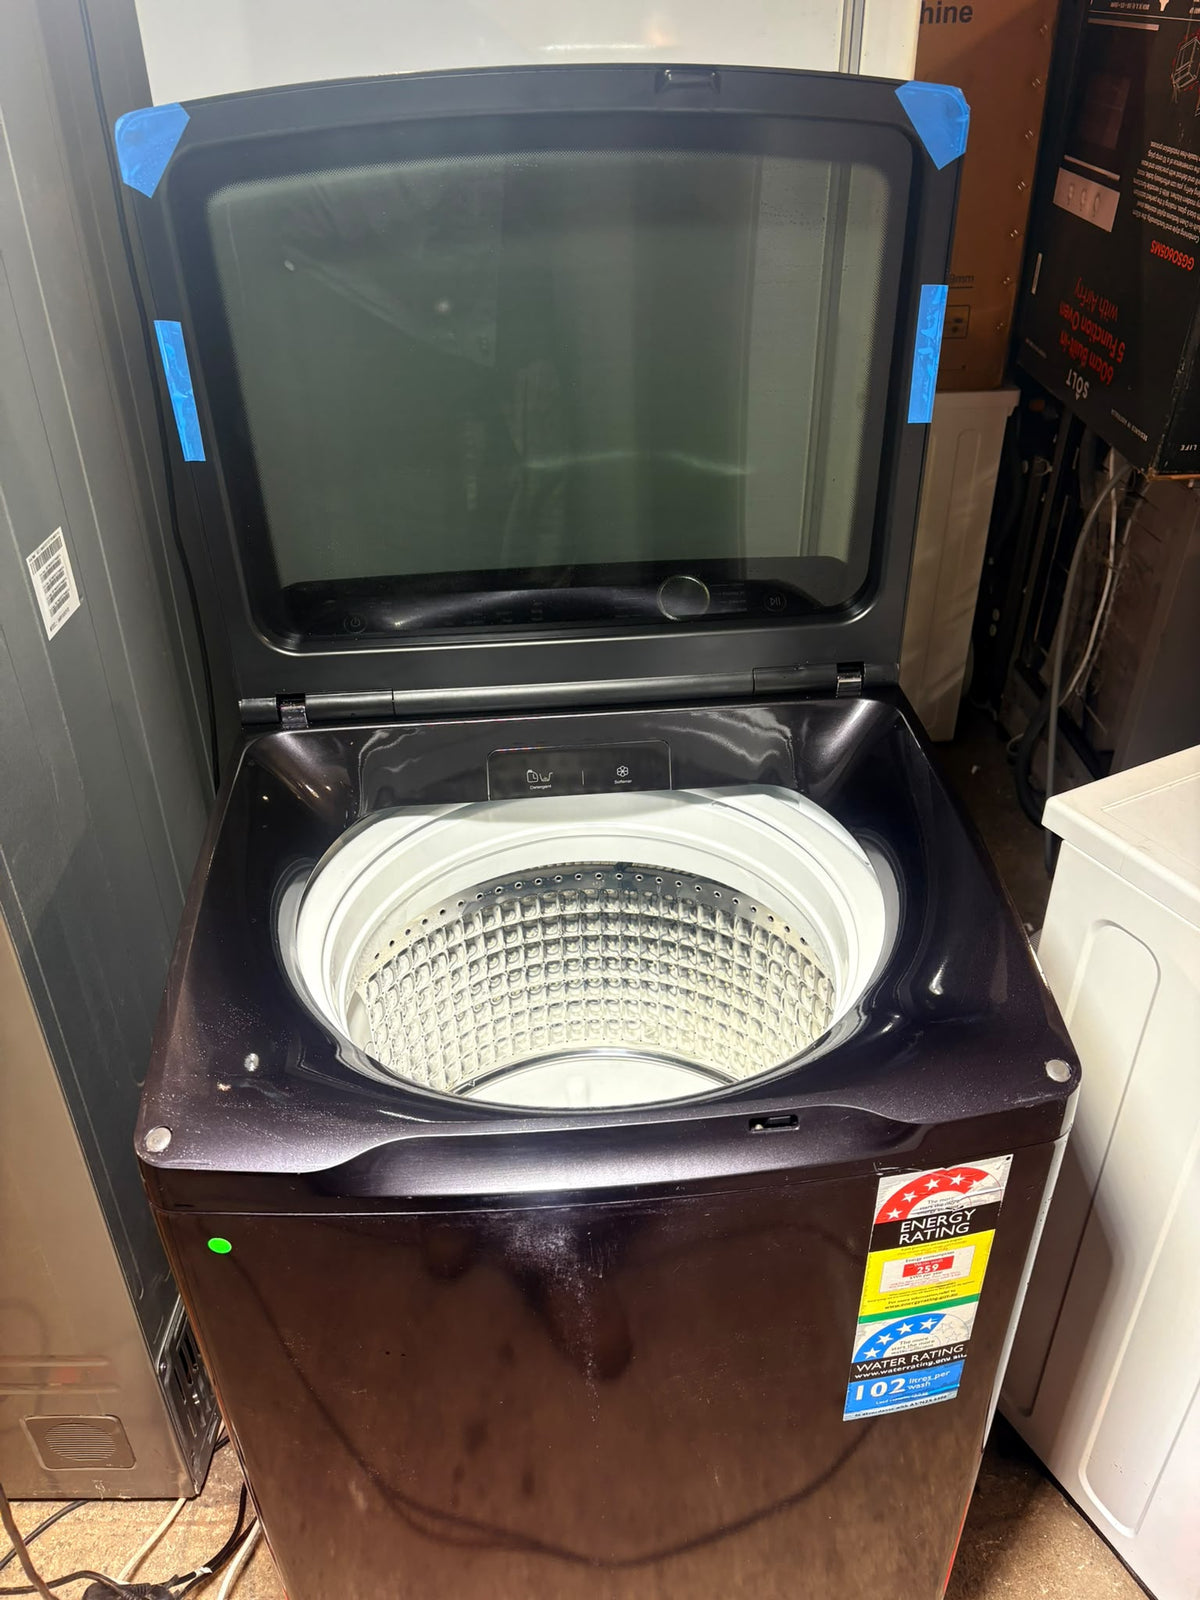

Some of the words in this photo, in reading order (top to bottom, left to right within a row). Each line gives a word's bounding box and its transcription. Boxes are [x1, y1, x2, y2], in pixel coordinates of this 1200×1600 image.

[920, 0, 973, 24] hine
[1060, 300, 1080, 331] Oven
[1099, 298, 1118, 322] with
[1080, 316, 1118, 358] Function
[1116, 342, 1125, 363] 5
[1089, 351, 1114, 385] 60cm
[900, 1208, 976, 1232] ENERGY
[899, 1222, 970, 1244] RATING
[916, 1264, 939, 1274] 259
[856, 1358, 906, 1372] WATER
[911, 1344, 964, 1362] RATING
[856, 1378, 906, 1400] 102
[907, 1381, 930, 1390] wash
[908, 1375, 932, 1384] litres
[934, 1370, 950, 1380] per
